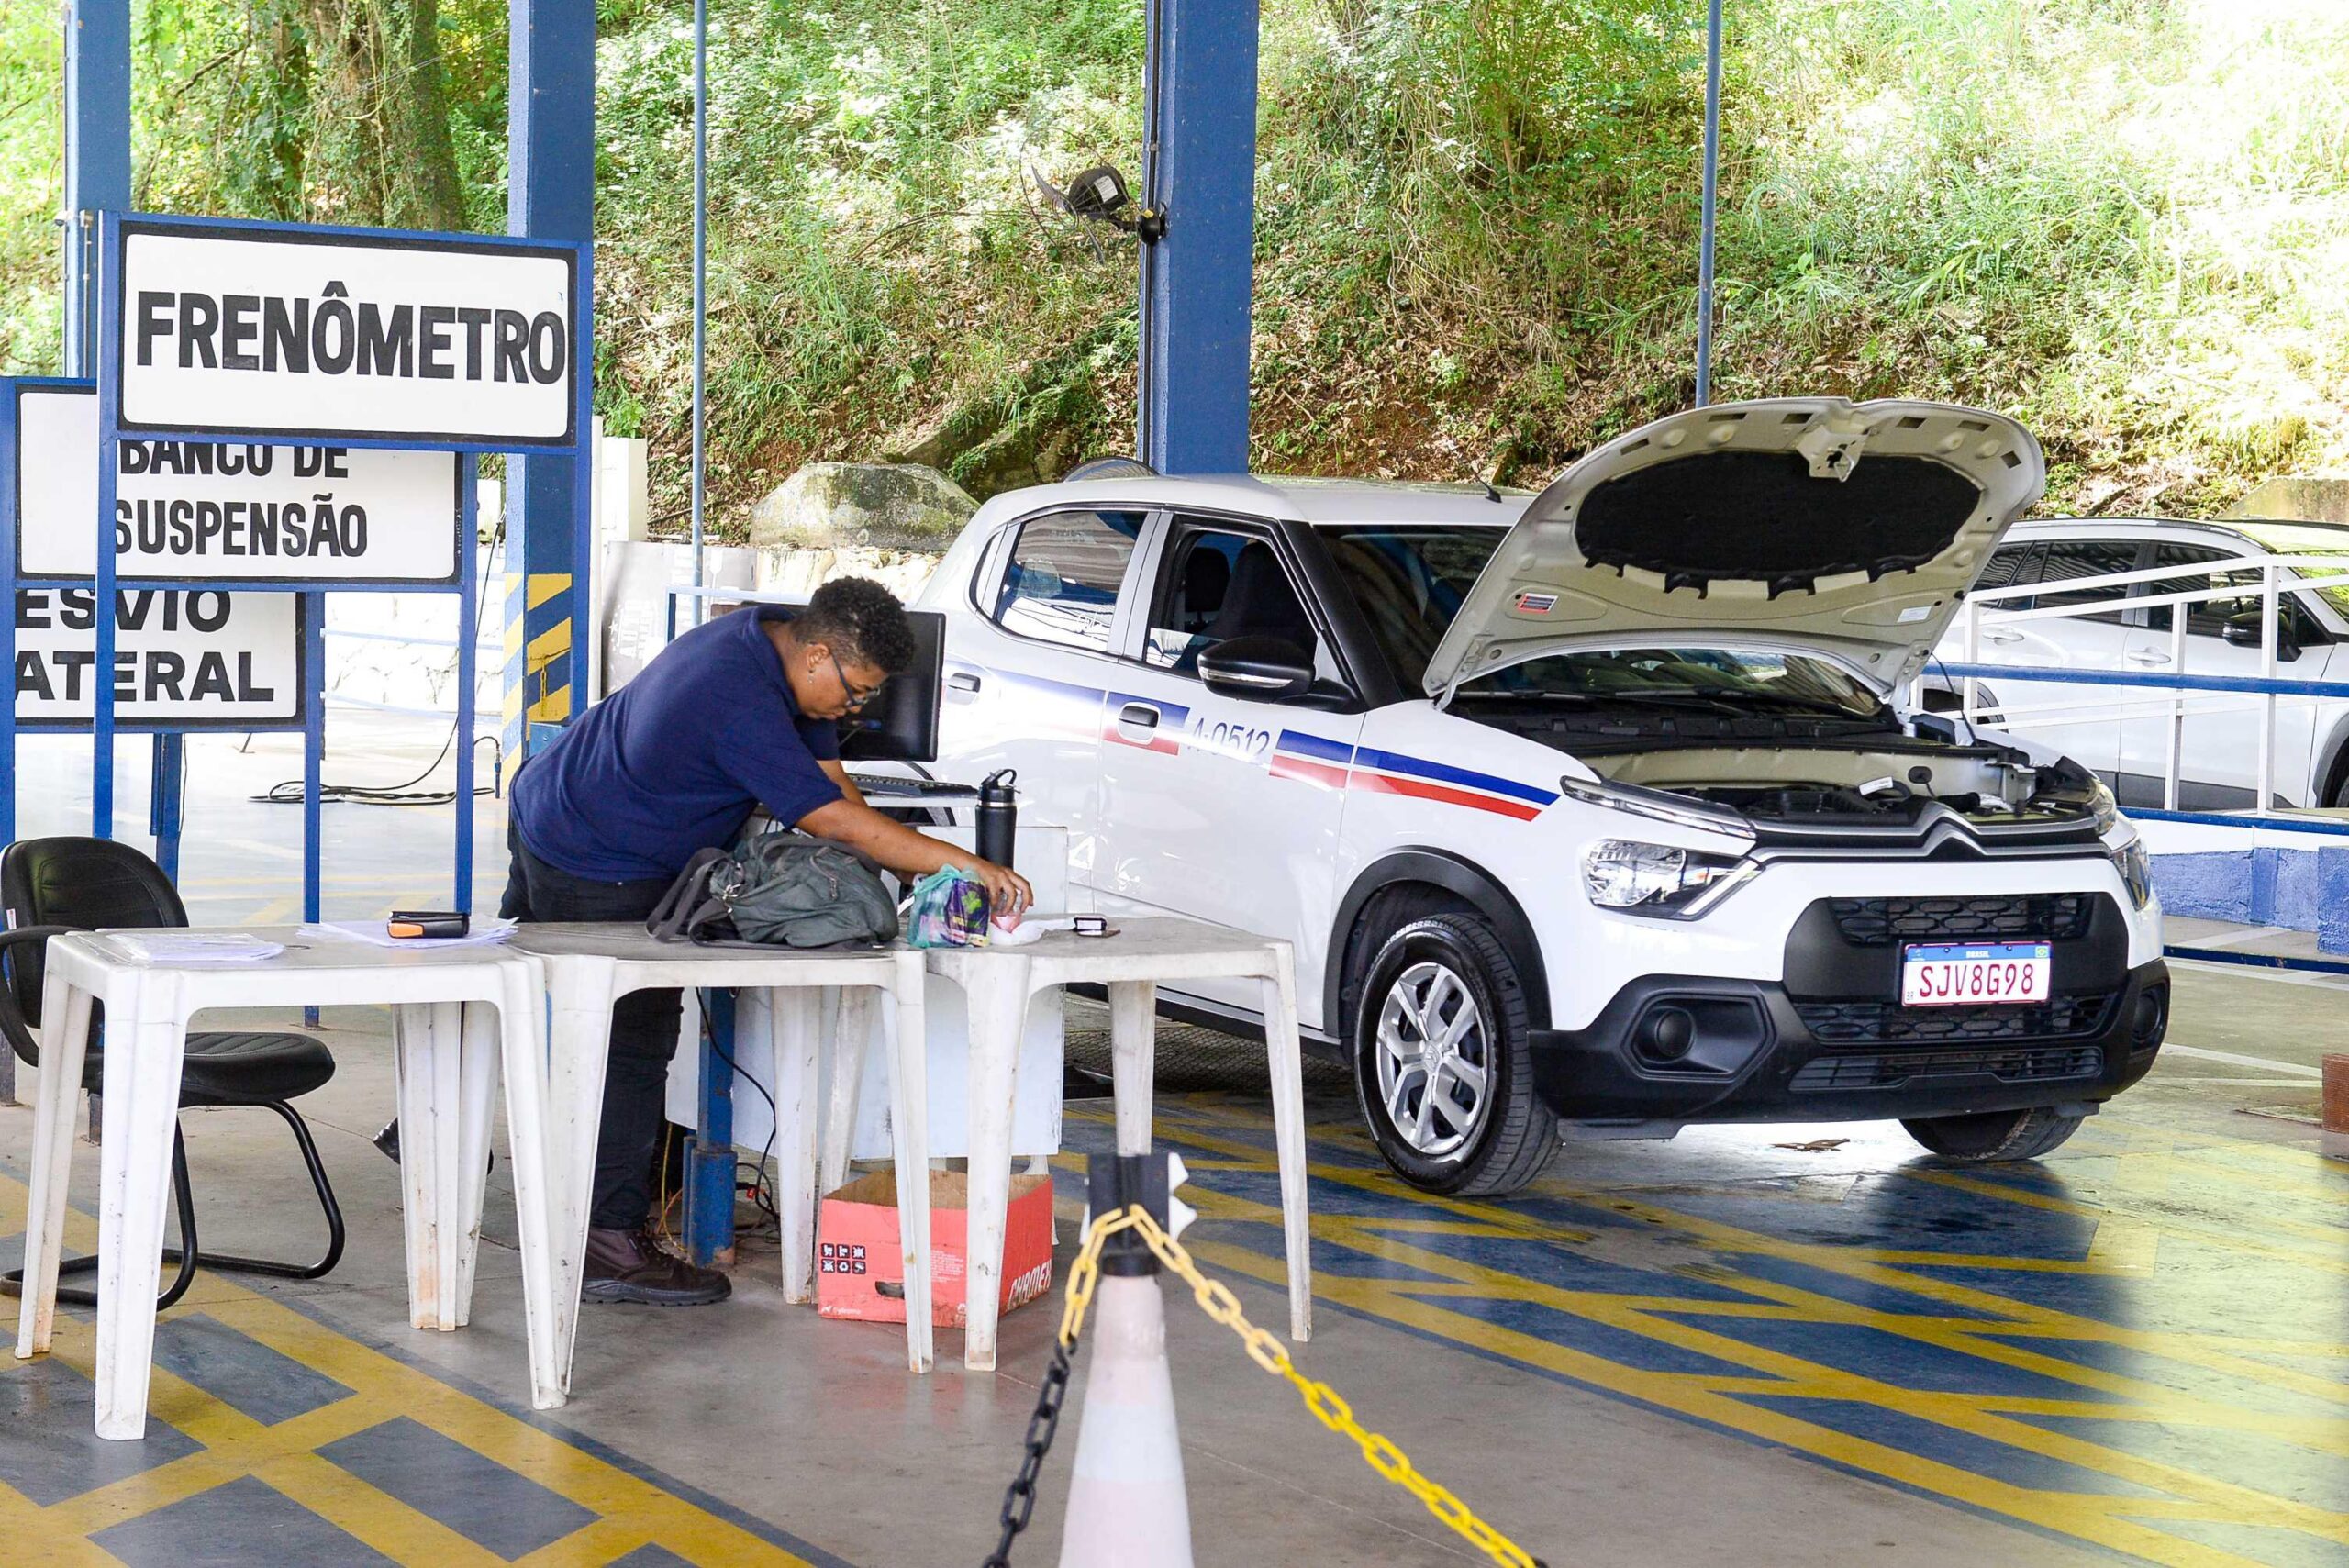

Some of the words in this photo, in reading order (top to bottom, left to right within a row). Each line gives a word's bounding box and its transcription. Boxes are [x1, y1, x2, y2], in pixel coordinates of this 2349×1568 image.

[137, 281, 565, 384] FRENÔMETRO
[294, 446, 349, 478] DE
[116, 493, 368, 557] SUSPENSÃO
[1920, 963, 2033, 996] SJV8G98
